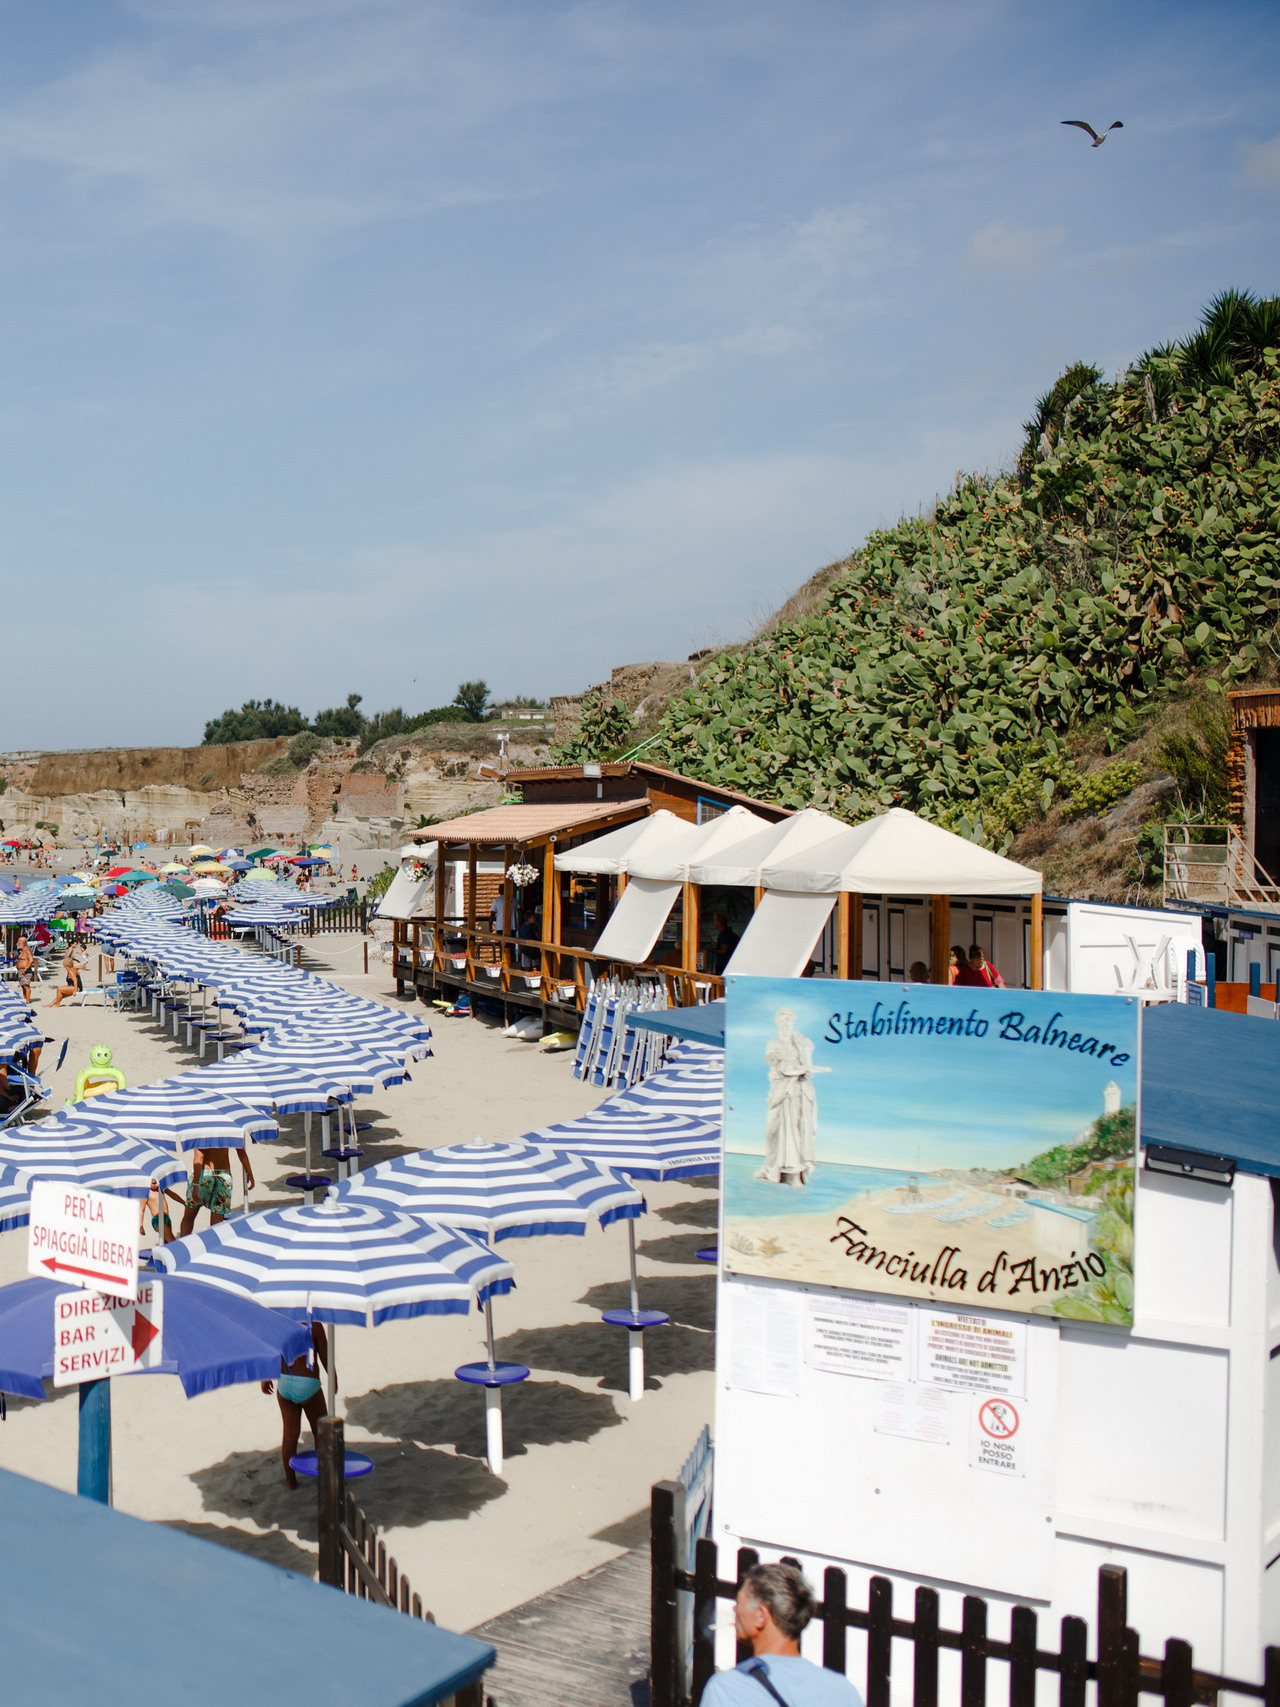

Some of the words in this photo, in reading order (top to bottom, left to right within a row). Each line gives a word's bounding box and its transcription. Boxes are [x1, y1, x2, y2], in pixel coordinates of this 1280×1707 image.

[824, 1000, 989, 1044] Stabilimento
[998, 1011, 1131, 1067] Balneare
[64, 1194, 86, 1219] PER
[89, 1199, 104, 1223] LA
[33, 1225, 88, 1258] SPIAGGIA
[91, 1238, 134, 1268] LIBERA
[829, 1216, 969, 1290] Fanciulla
[977, 1250, 1107, 1295] d'Anzio
[60, 1287, 153, 1319] DIREZIONE
[931, 1319, 972, 1332] L'INGRESSO
[982, 1327, 1013, 1338] ANIMALI
[957, 1315, 987, 1326] VIETATO
[60, 1325, 95, 1347] BAR
[59, 1346, 125, 1374] SERVIZI
[980, 1440, 990, 1448] IO
[993, 1442, 1015, 1452] NON
[983, 1448, 1012, 1460] POSSO
[978, 1456, 1016, 1470] ENTRARE
